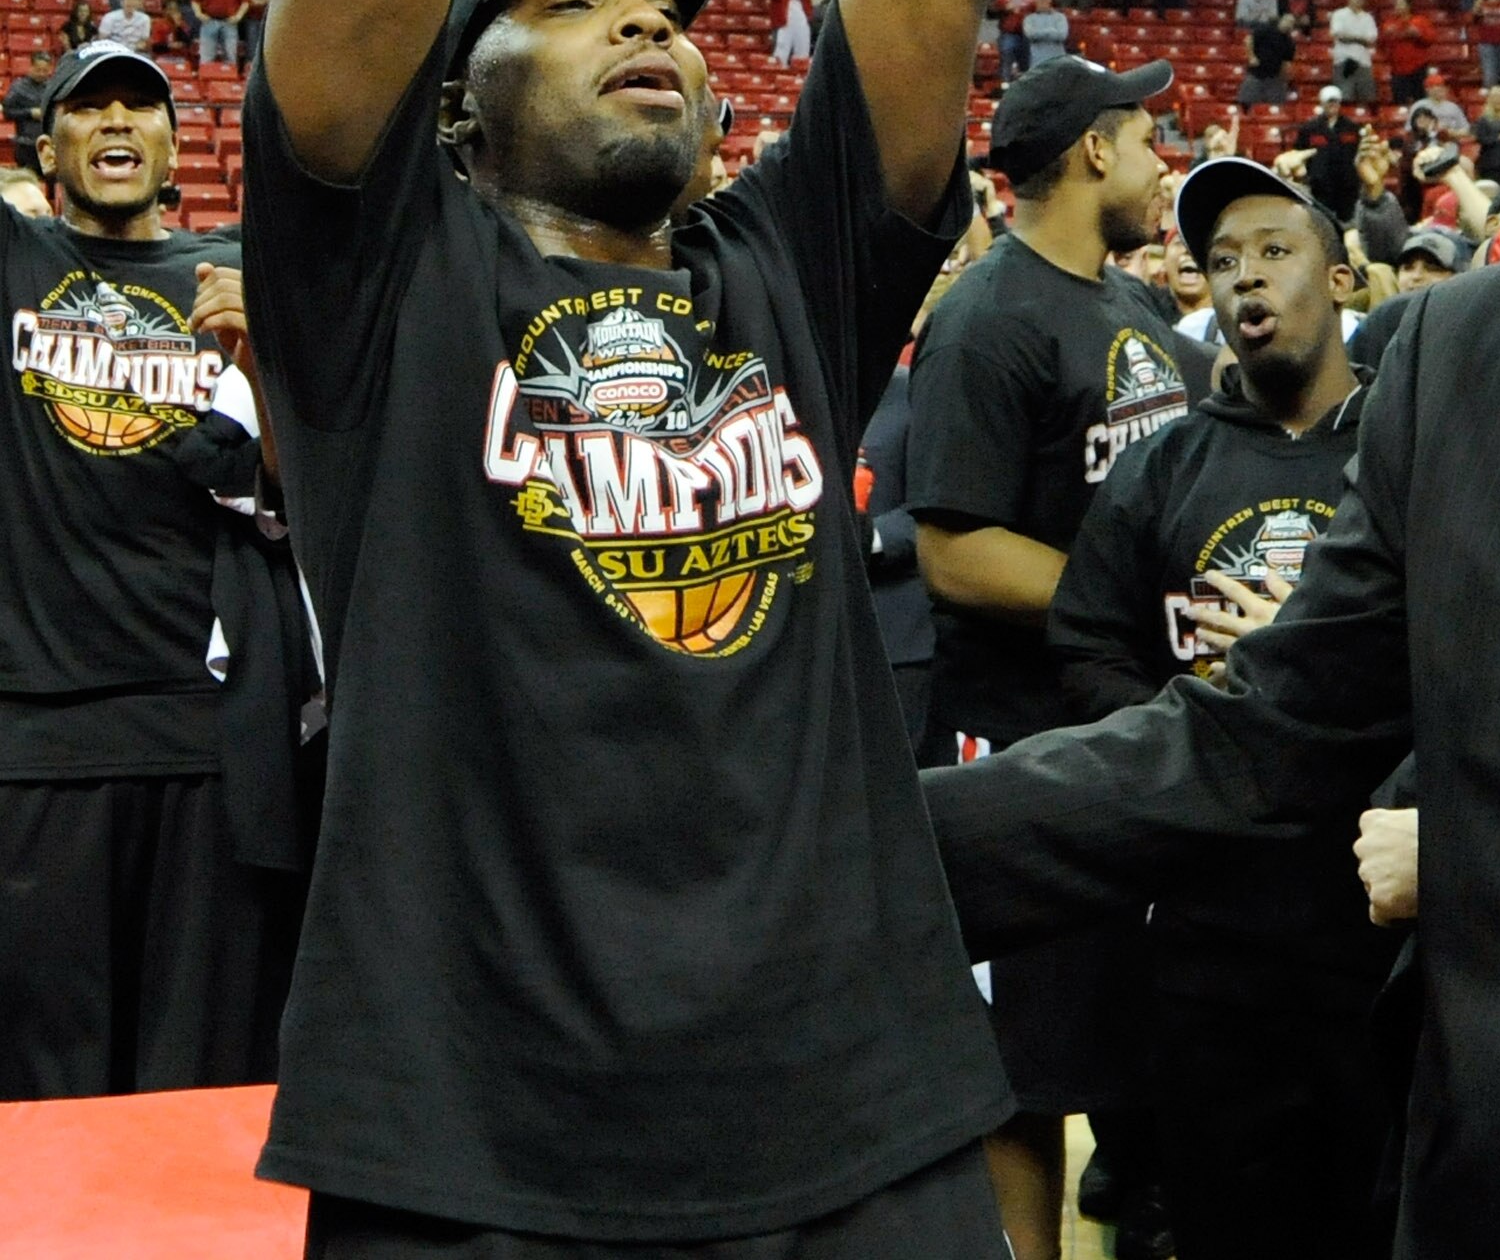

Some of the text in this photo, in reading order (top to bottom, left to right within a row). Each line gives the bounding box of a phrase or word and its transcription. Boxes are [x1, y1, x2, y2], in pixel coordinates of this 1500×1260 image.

[589, 322, 664, 353] MOUNTAIN
[597, 343, 655, 361] WEST
[12, 307, 224, 413] CHAMPIONS
[587, 361, 685, 384] HAMPIONSHIPS
[43, 379, 111, 408] SDSU
[596, 385, 661, 400] conoco
[679, 512, 815, 576] AZTECS
[1195, 507, 1255, 572] MOUNTAIN
[1258, 498, 1300, 513] WEST
[570, 548, 606, 593] MARCH
[749, 609, 767, 633] LAS
[762, 571, 780, 611] VEGAS
